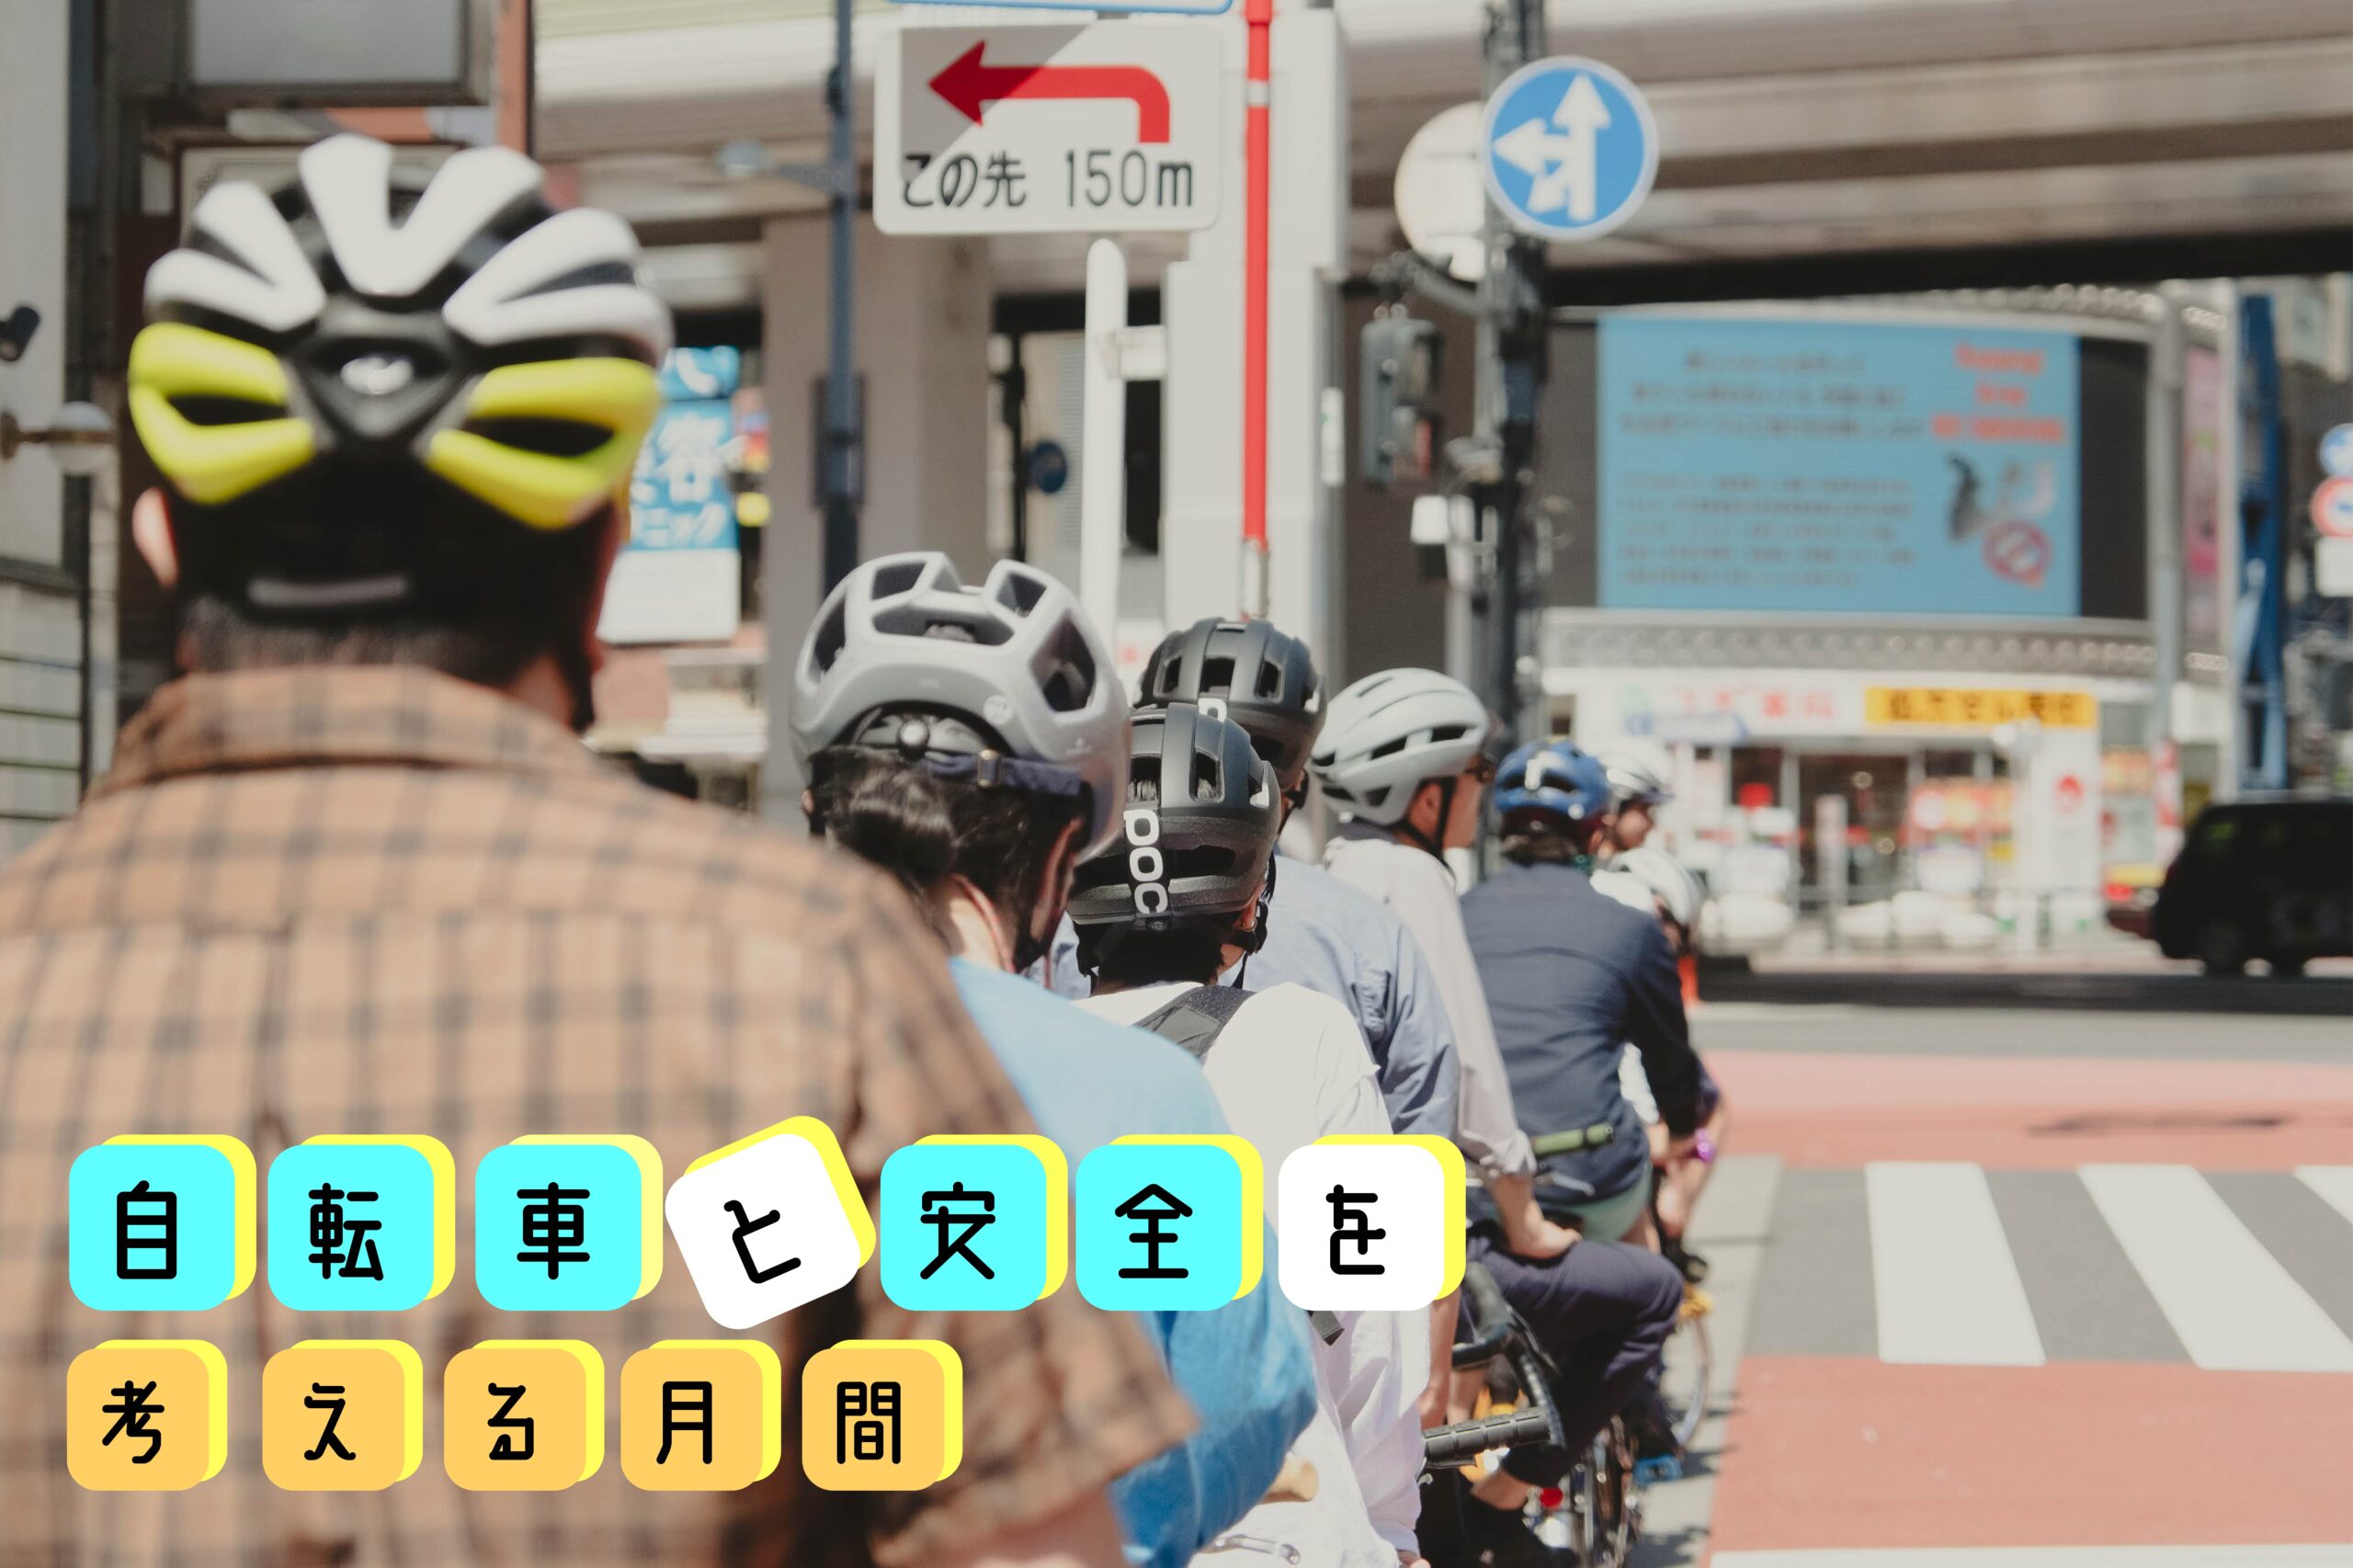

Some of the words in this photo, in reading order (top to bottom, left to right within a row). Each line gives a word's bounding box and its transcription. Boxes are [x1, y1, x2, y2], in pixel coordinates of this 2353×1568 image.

[904, 151, 1027, 208] この先
[1067, 150, 1192, 207] 150m
